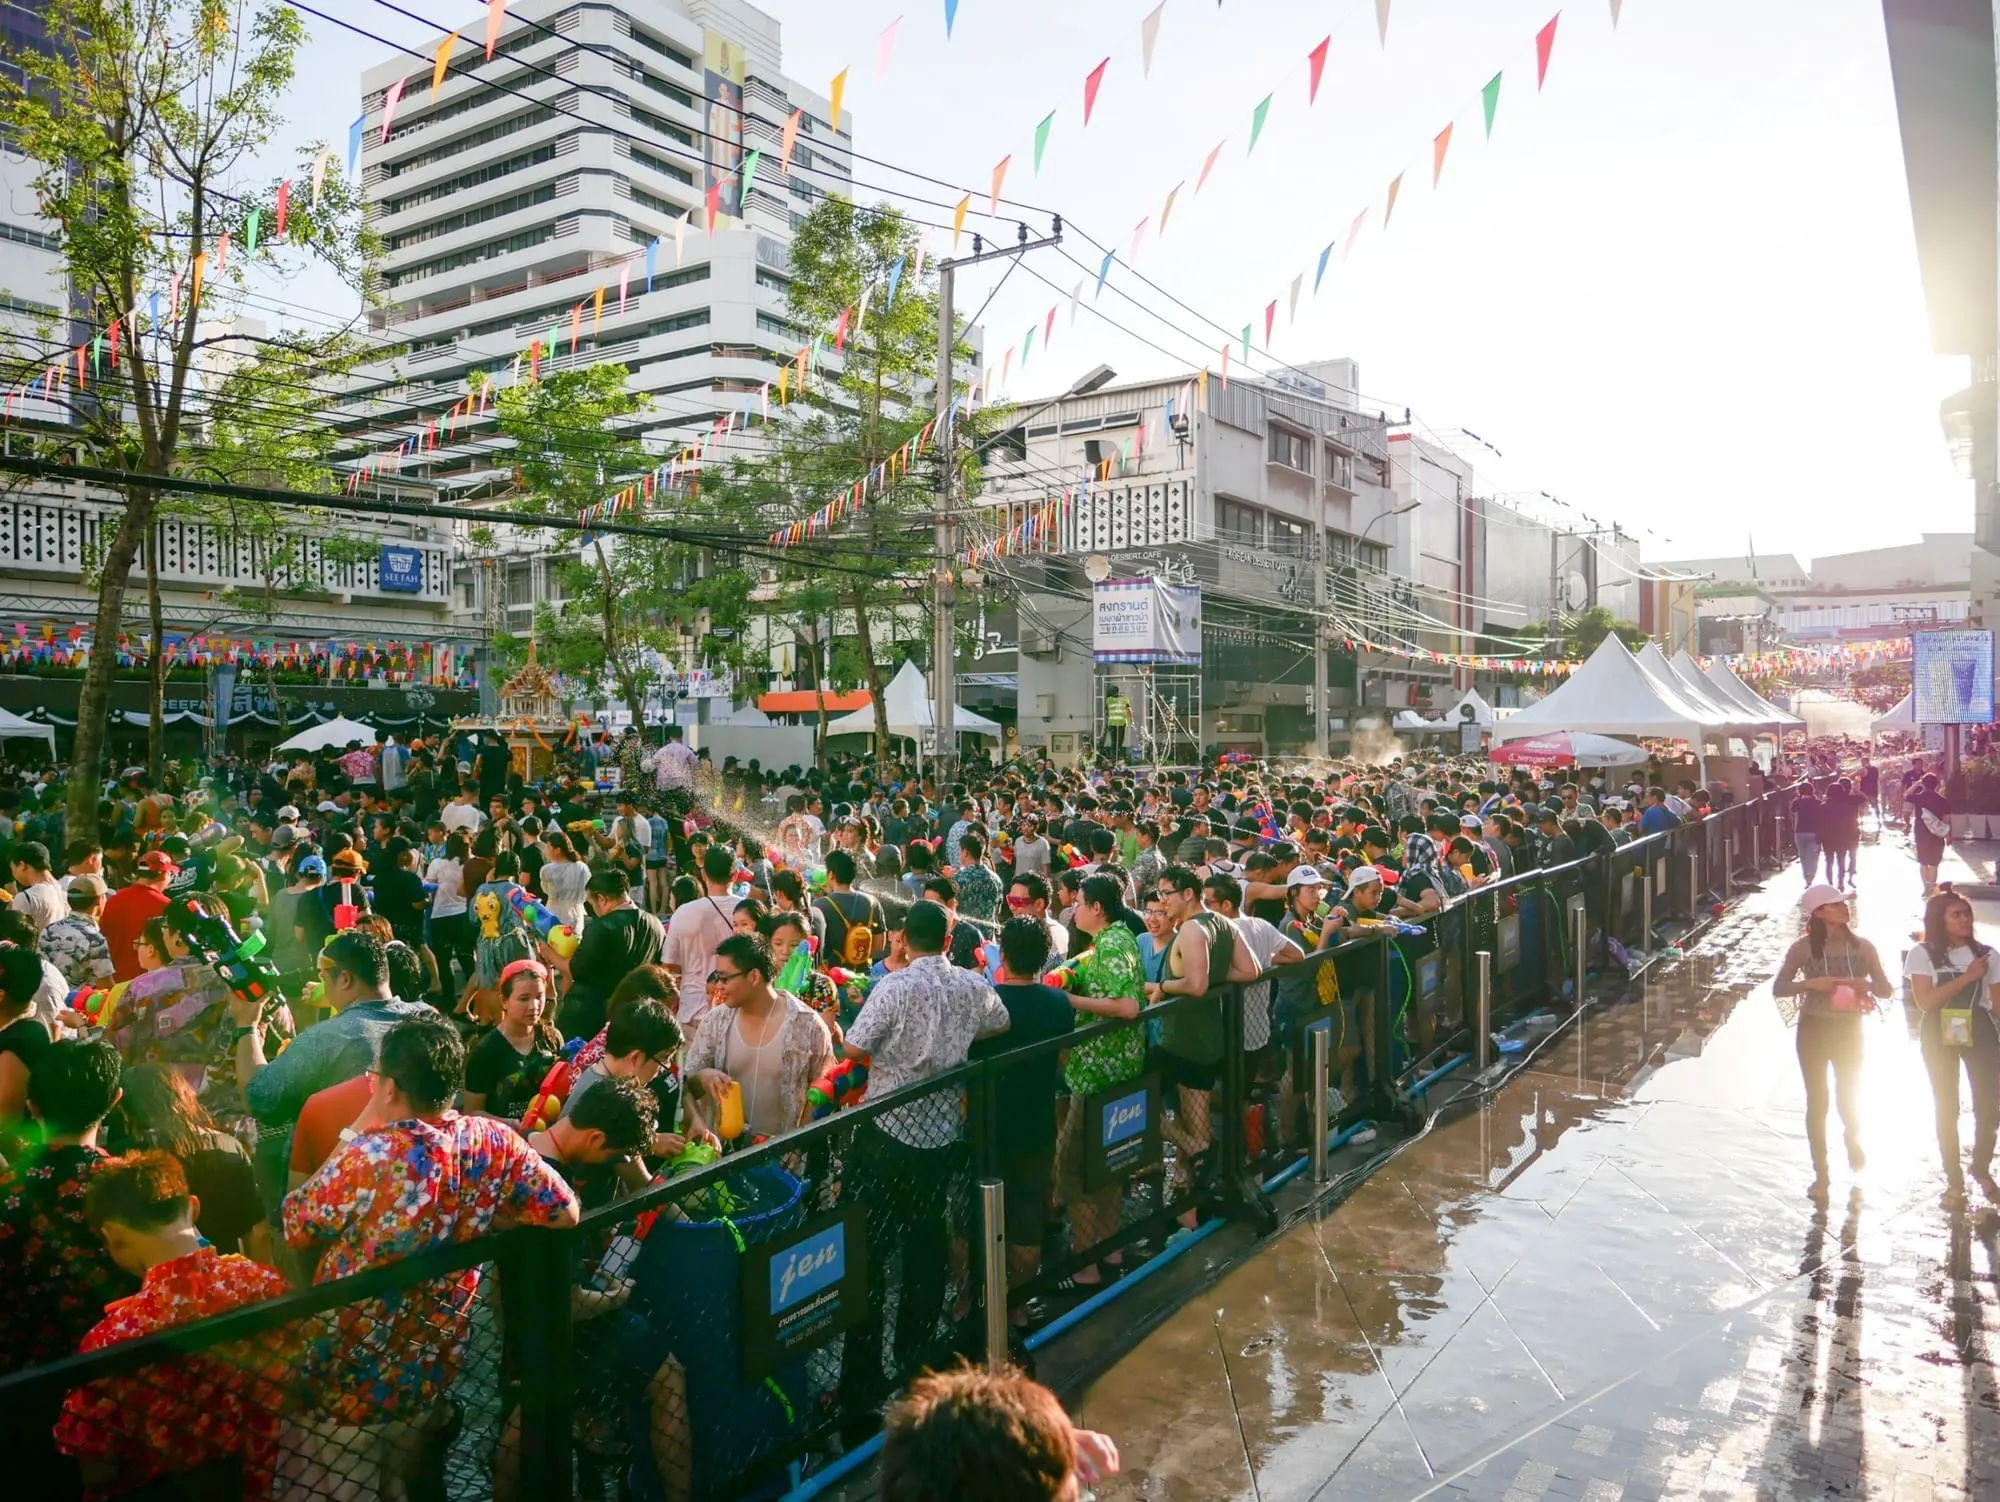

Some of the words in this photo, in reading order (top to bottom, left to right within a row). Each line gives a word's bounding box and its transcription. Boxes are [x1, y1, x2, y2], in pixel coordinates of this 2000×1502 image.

[1111, 552, 1141, 562] DESSERT
[1143, 550, 1162, 560] CAFE
[384, 573, 399, 582] SEE
[1099, 597, 1149, 613] สงกรานต์
[1108, 1103, 1143, 1140] jen
[779, 1242, 838, 1304] jen
